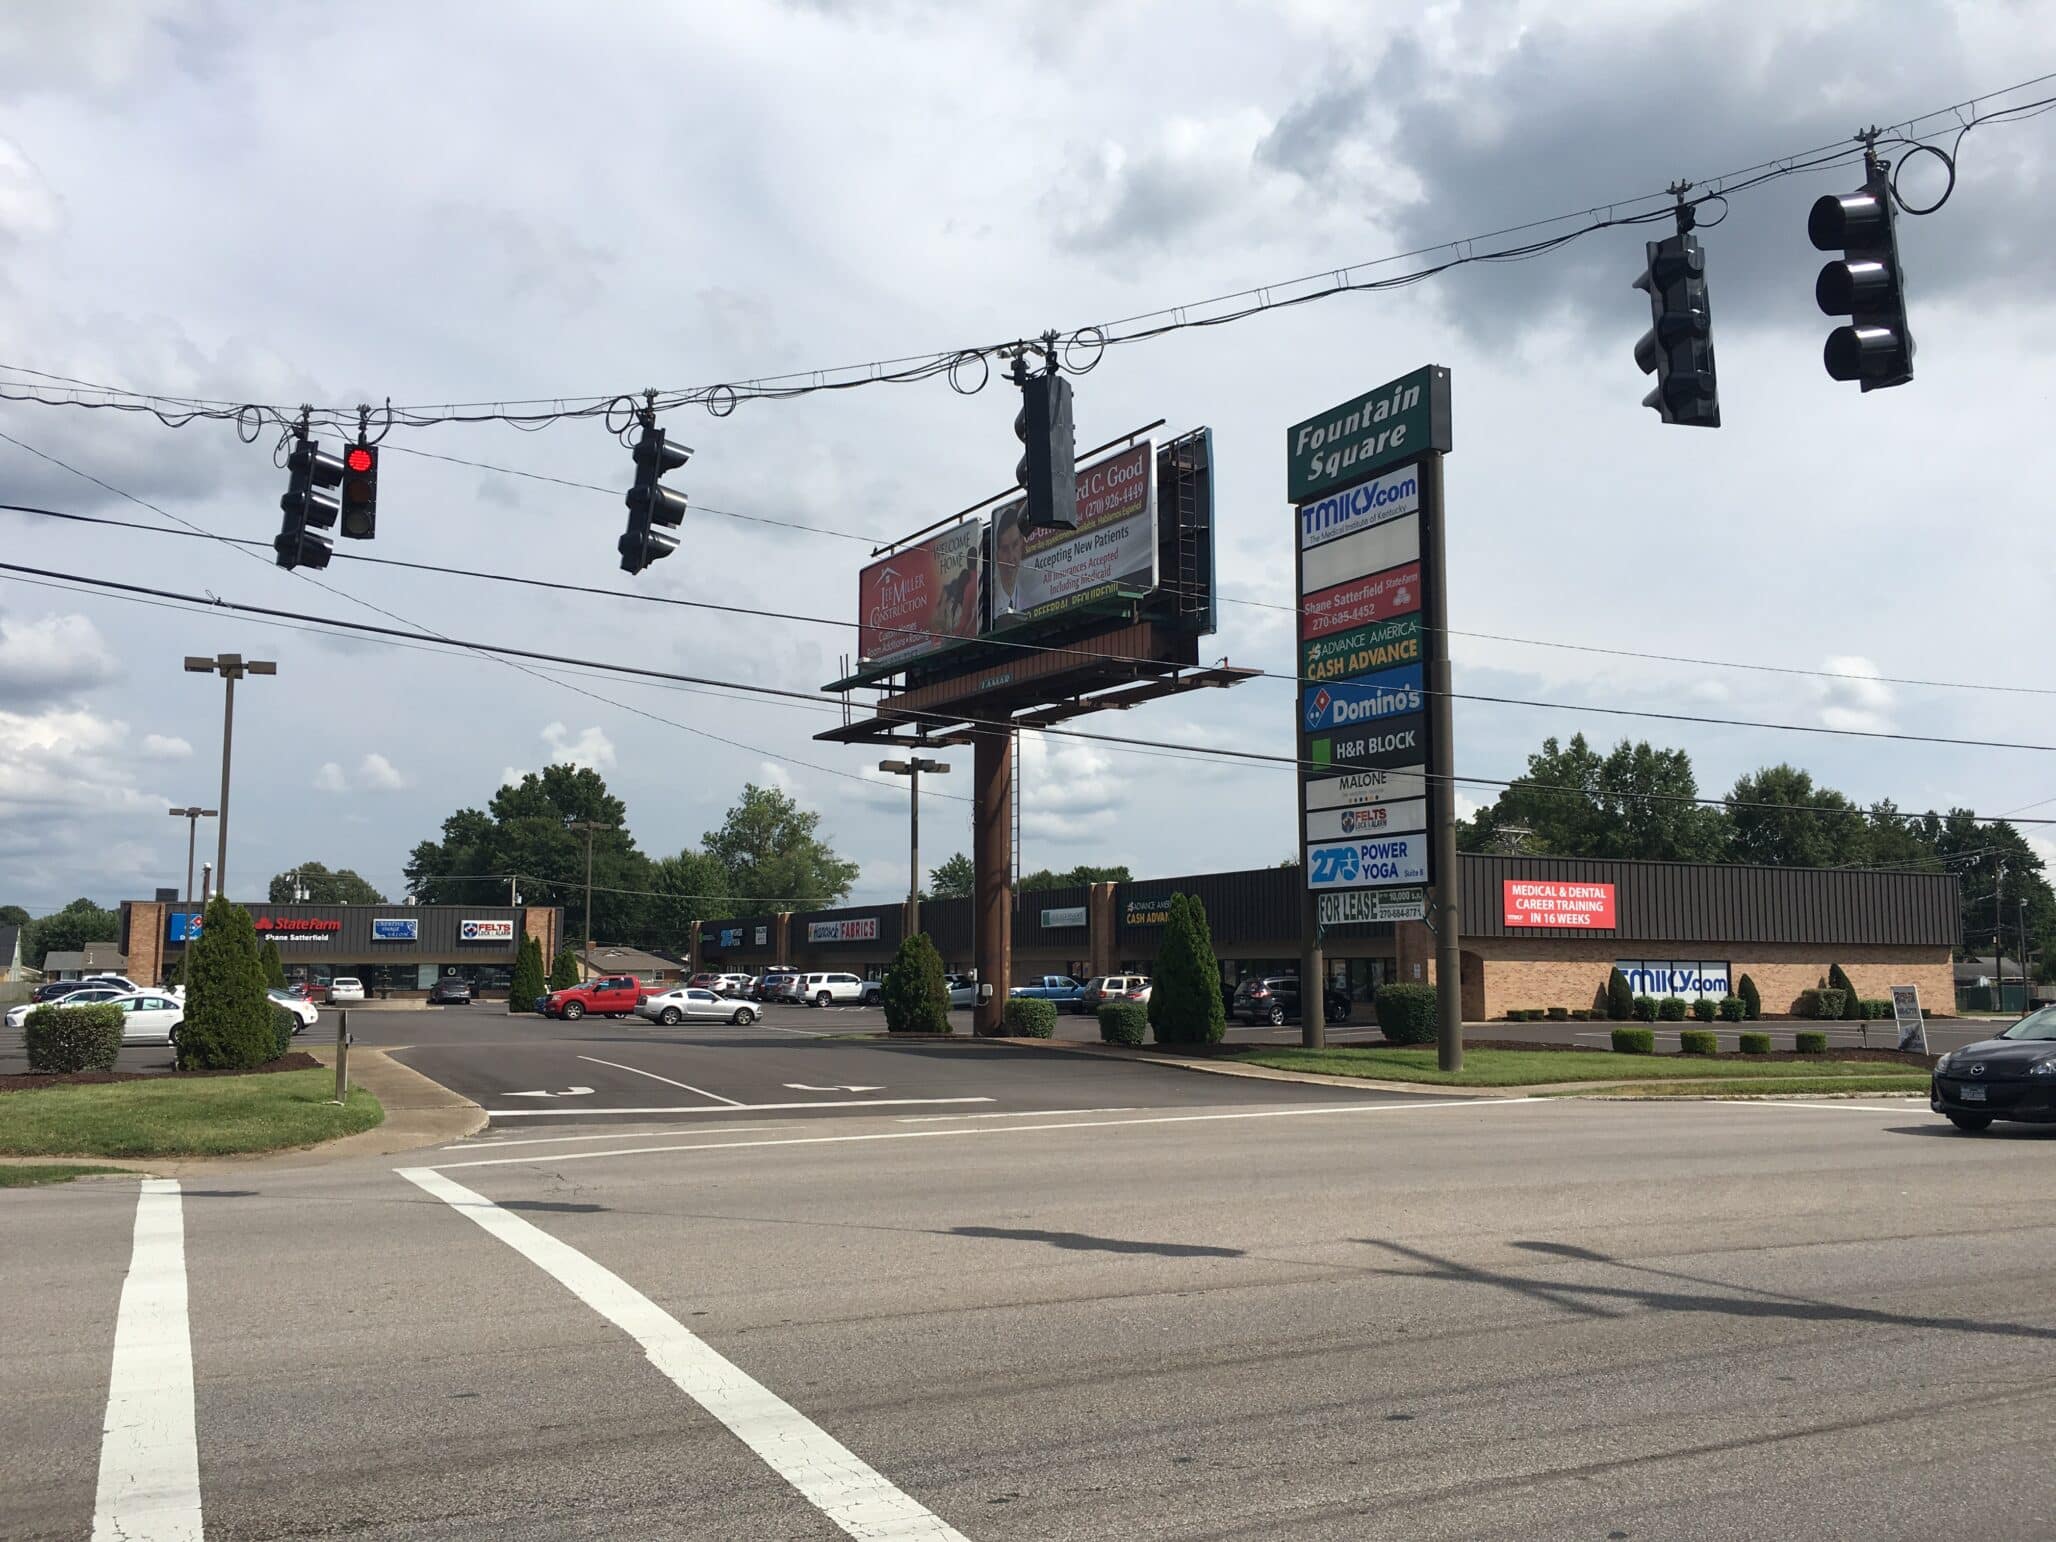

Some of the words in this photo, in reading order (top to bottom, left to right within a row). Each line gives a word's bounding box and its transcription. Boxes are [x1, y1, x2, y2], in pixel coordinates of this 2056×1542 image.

[1296, 384, 1420, 456] Fountain
[1308, 424, 1407, 481] Square
[1091, 473, 1105, 494] C.
[1107, 455, 1143, 488] Good
[1085, 497, 1104, 518] (270)
[934, 532, 970, 558] WELCOME
[1034, 546, 1073, 569] Accepting
[1074, 536, 1093, 555] New
[1095, 525, 1129, 548] Patients
[940, 553, 965, 575] HOME
[1043, 572, 1052, 584] All
[1053, 561, 1087, 581] Insurances
[1088, 550, 1119, 572] Accepted
[1050, 573, 1080, 593] Including
[1081, 565, 1112, 584] Medicaid
[1304, 600, 1334, 615] Shane
[1334, 581, 1384, 607] Satterfield
[870, 595, 928, 630] CONSTRUCTION
[1321, 633, 1366, 656] ADVANCE
[1369, 620, 1417, 644] AMERICA
[1308, 657, 1344, 680] CASH
[1348, 639, 1418, 672] ADVANCE
[1333, 683, 1420, 724] Domino's
[1336, 740, 1365, 759] H&R
[1368, 730, 1416, 754] BLOCK
[1339, 771, 1387, 791] MALONE
[1355, 808, 1387, 822] FELTS
[1312, 846, 1360, 883] 270
[1361, 842, 1408, 860] POWER
[1362, 863, 1399, 880] YOGA
[1512, 885, 1557, 896] MEDICAL
[1560, 887, 1567, 897] &
[1569, 887, 1606, 898] DENTAL
[1516, 899, 1554, 910] CAREER
[1557, 900, 1604, 912] TRAINING
[1127, 913, 1145, 924] CASH
[1147, 912, 1169, 923] ADVAN
[1133, 902, 1155, 911] ADVANCE
[1320, 893, 1340, 922] FOR
[1343, 890, 1378, 921] LEASE
[1530, 912, 1540, 923] IN
[1544, 913, 1555, 924] 16
[1557, 914, 1590, 924] WEEKS
[478, 923, 511, 931] FELTS
[841, 920, 875, 938] FABRICS
